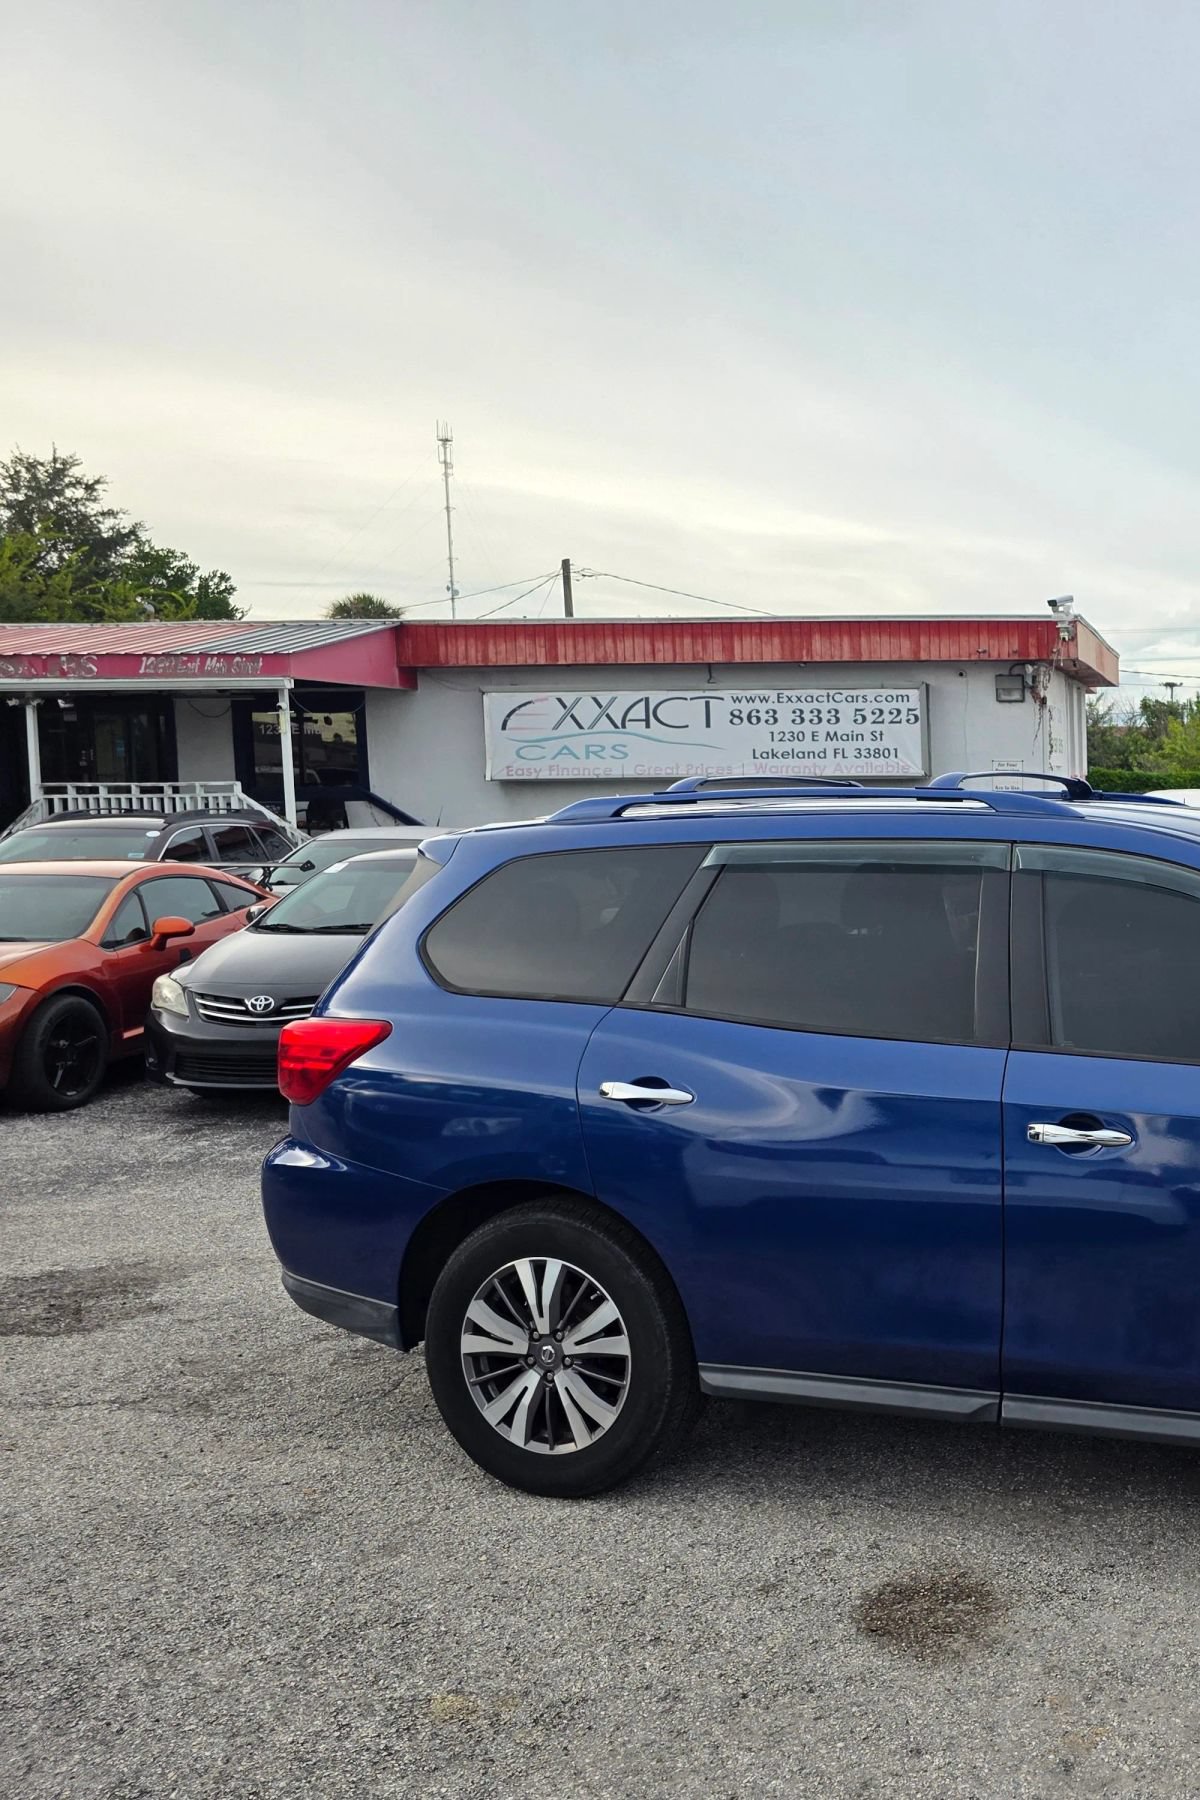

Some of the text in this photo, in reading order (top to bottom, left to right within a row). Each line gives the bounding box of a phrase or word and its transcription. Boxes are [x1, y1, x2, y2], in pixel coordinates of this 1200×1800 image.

[730, 692, 910, 704] www.ExxactCars.com
[501, 696, 725, 731] EXXACT
[729, 707, 920, 726] 863 333 5225
[259, 724, 281, 735] 123
[769, 730, 885, 743] 1230 E Main St
[515, 744, 630, 761] CARS
[752, 747, 899, 760] Lakeland FL 33801
[506, 760, 911, 778] Easy Finance Great Prices Warranty Available
